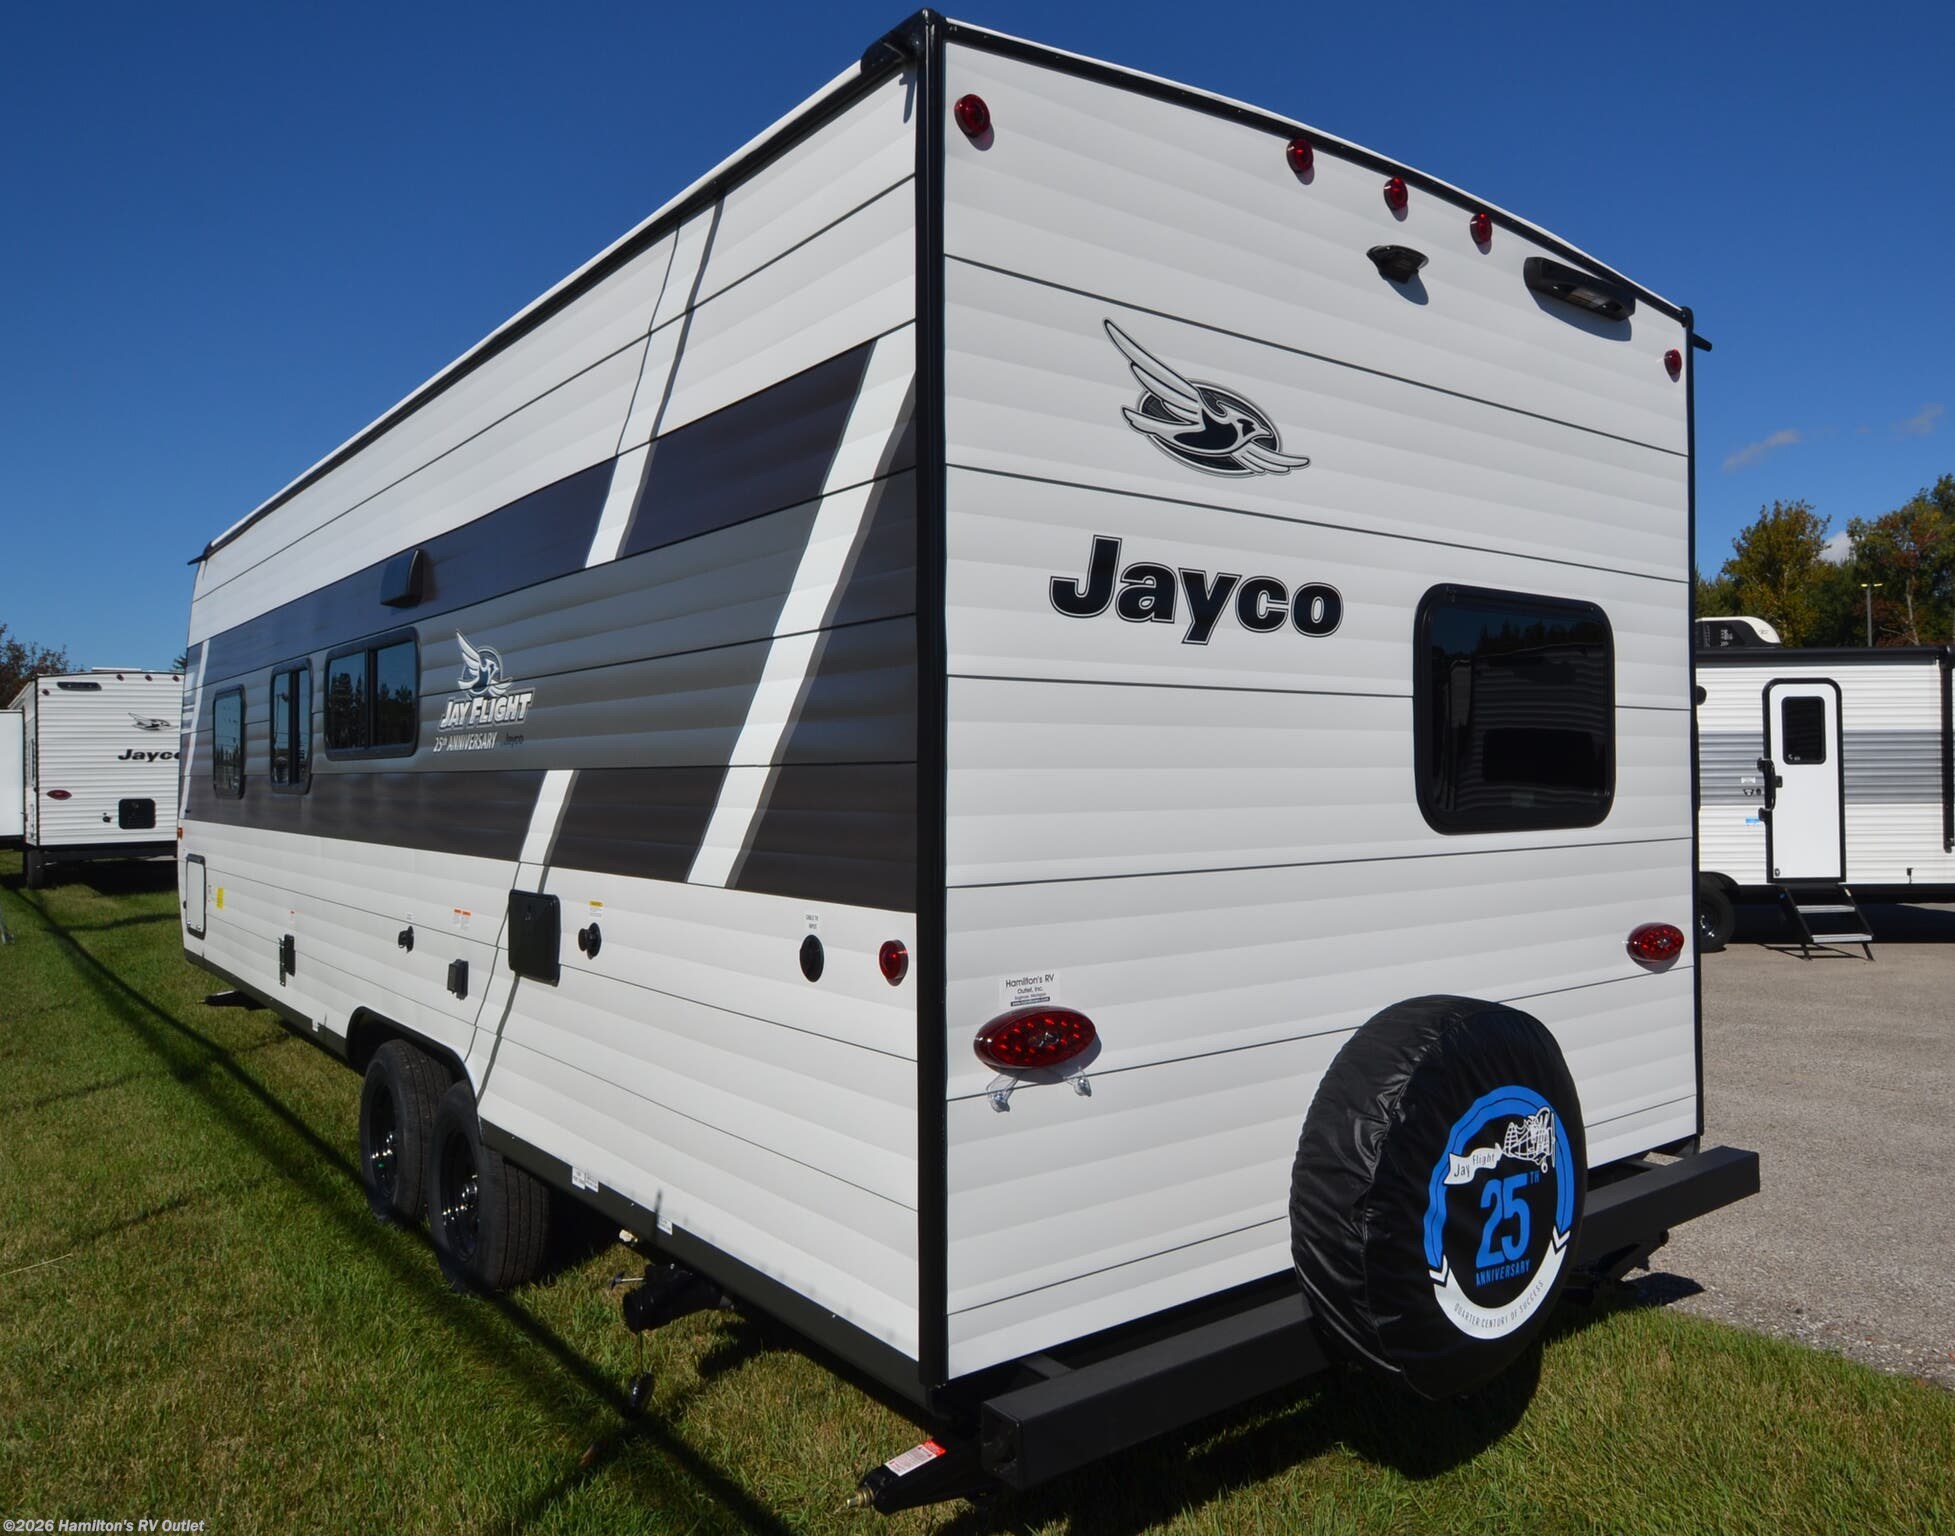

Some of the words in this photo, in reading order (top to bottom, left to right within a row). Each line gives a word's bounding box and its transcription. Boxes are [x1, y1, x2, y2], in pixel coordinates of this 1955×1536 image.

[1049, 535, 1344, 645] Jayco
[439, 698, 471, 730] JAY
[467, 691, 533, 727] FLIGHT
[446, 732, 498, 751] ANNIVERSARY
[1005, 976, 1043, 988] Hamilton's
[1045, 974, 1055, 983] RV
[1454, 1163, 1471, 1178] Jay
[1472, 1153, 1496, 1166] Flight
[1476, 1258, 1531, 1288] ANNIVERSARY
[1454, 1302, 1481, 1326] QUARTER
[1481, 1314, 1509, 1329] CENTURY
[1510, 1310, 1519, 1321] OF
[1519, 1281, 1545, 1313] SUCCESS
